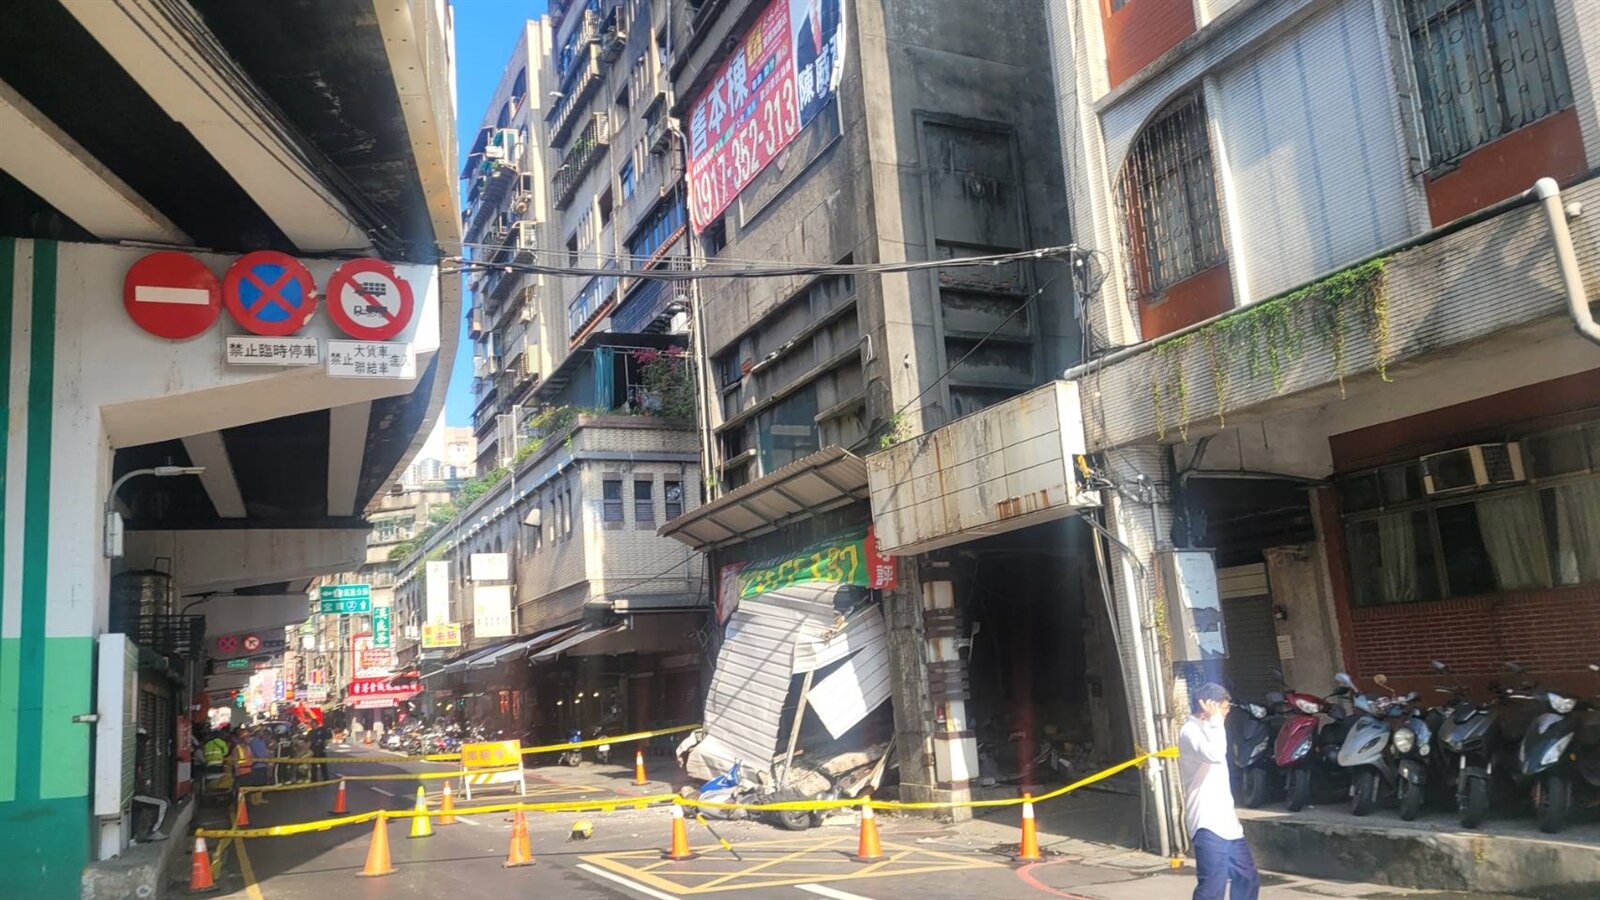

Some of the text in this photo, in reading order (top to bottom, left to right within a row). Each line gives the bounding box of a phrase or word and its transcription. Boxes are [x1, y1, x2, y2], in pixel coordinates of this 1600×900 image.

[229, 343, 317, 358] 禁止臨時停車
[354, 344, 389, 358] 大貨車
[330, 353, 354, 366] 禁止
[388, 354, 412, 367] 進入
[354, 361, 389, 375] 聯結車
